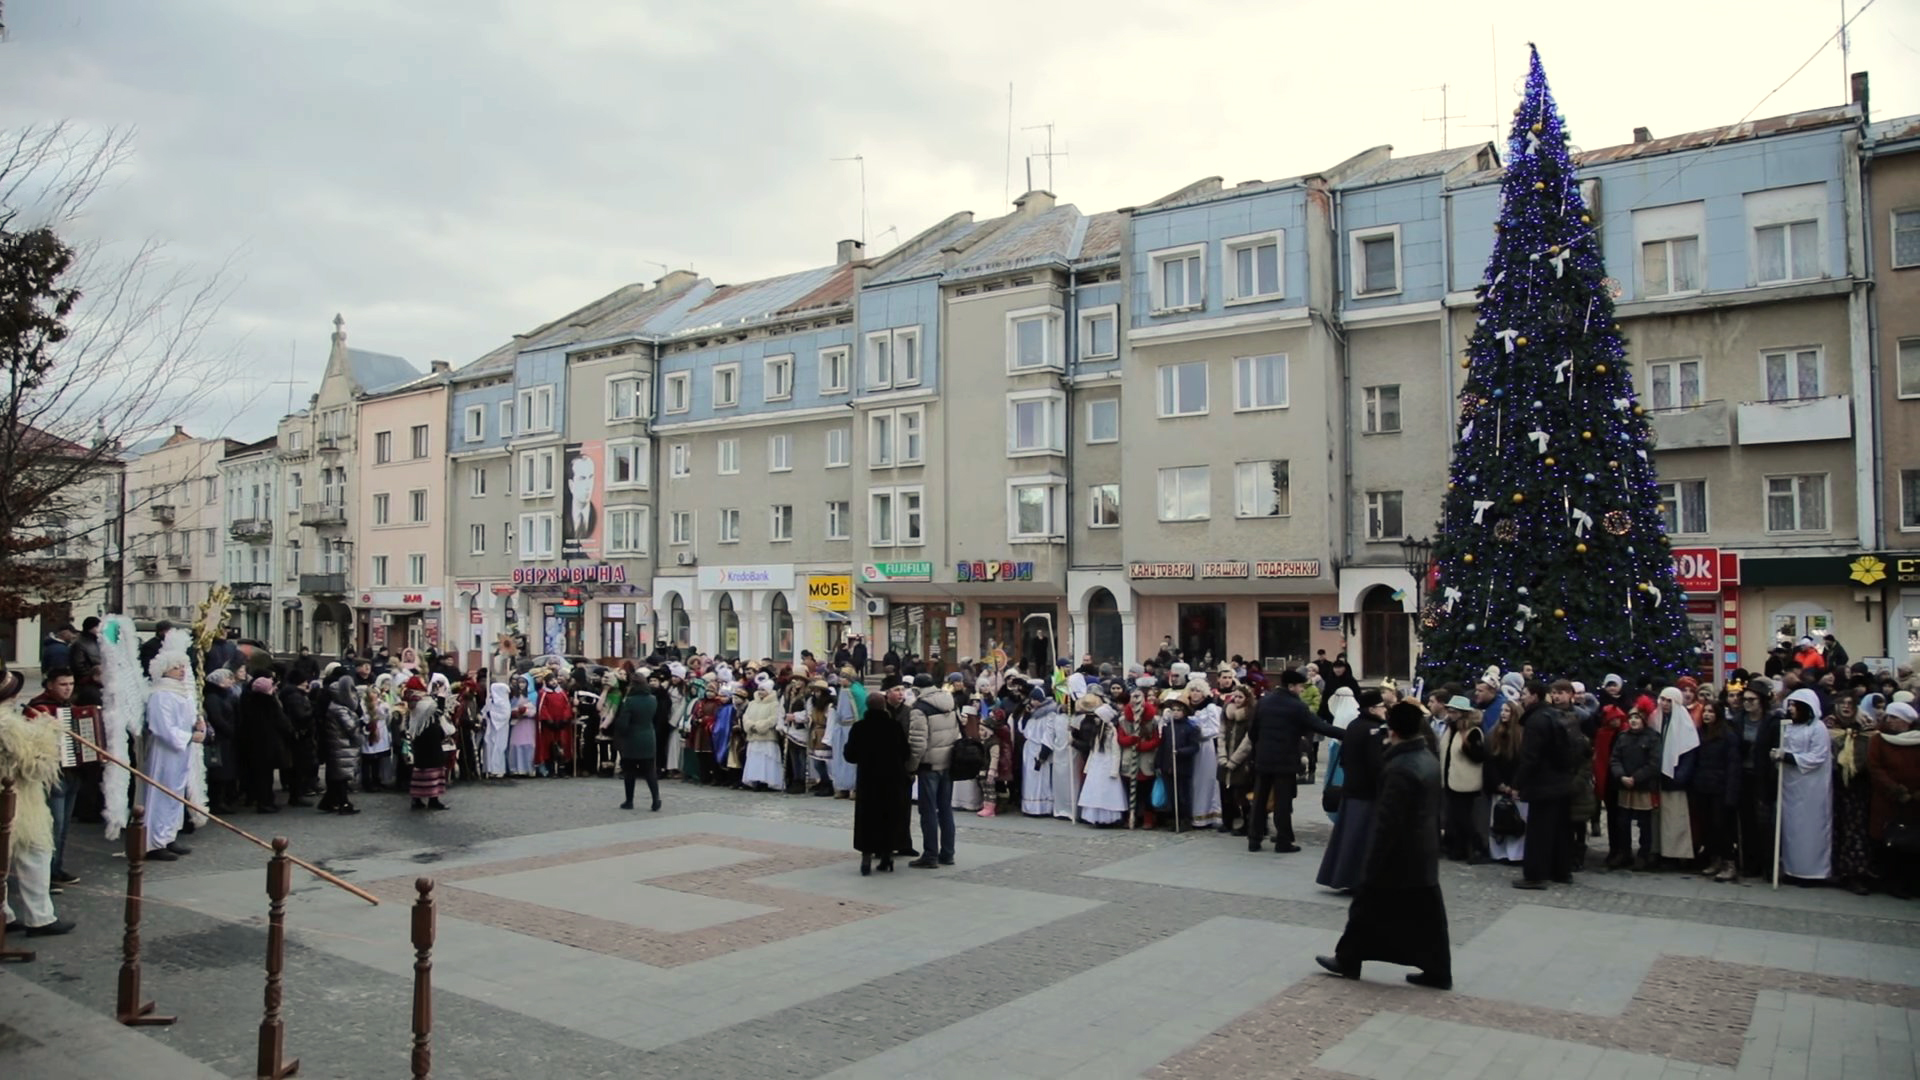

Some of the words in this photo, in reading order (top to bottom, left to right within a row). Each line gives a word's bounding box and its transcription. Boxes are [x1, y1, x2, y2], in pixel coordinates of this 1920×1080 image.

[512, 565, 626, 584] ВЕРХОВИНА
[885, 562, 930, 574] FUJIFILM
[1130, 562, 1193, 577] КАНЦТОВАРИ
[1201, 561, 1247, 577] ІГРАШКИ
[1256, 560, 1319, 577] ПОДАРУНКИ
[727, 570, 769, 581] KredoBank
